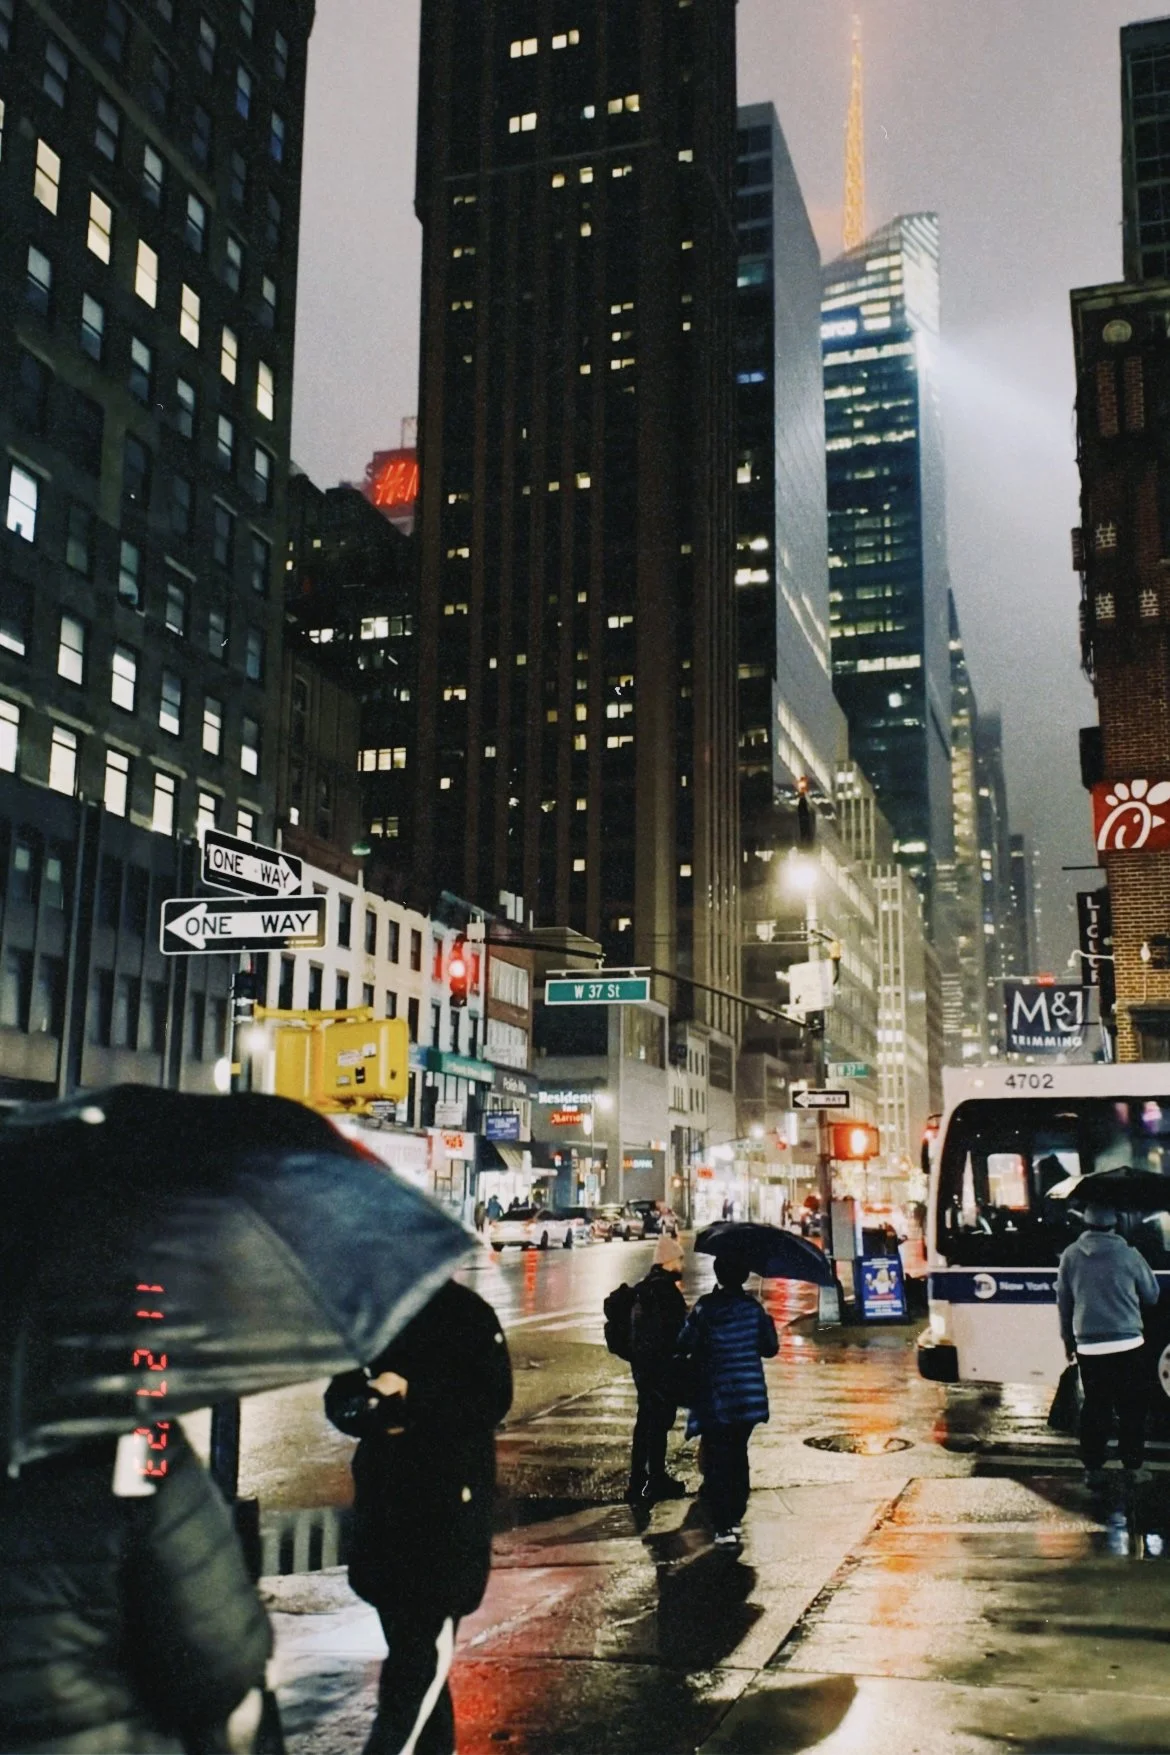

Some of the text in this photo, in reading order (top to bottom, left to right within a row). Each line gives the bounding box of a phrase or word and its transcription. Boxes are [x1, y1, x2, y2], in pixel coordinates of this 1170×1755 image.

[213, 848, 290, 889] ONE WAY
[185, 913, 311, 936] ONE WAY
[574, 984, 620, 999] W 37 St
[1013, 990, 1083, 1032] M&J
[1011, 1034, 1083, 1047] TRIMMING
[1004, 1073, 1054, 1089] 4702
[1000, 1281, 1024, 1291] New
[1025, 1281, 1050, 1291] York
